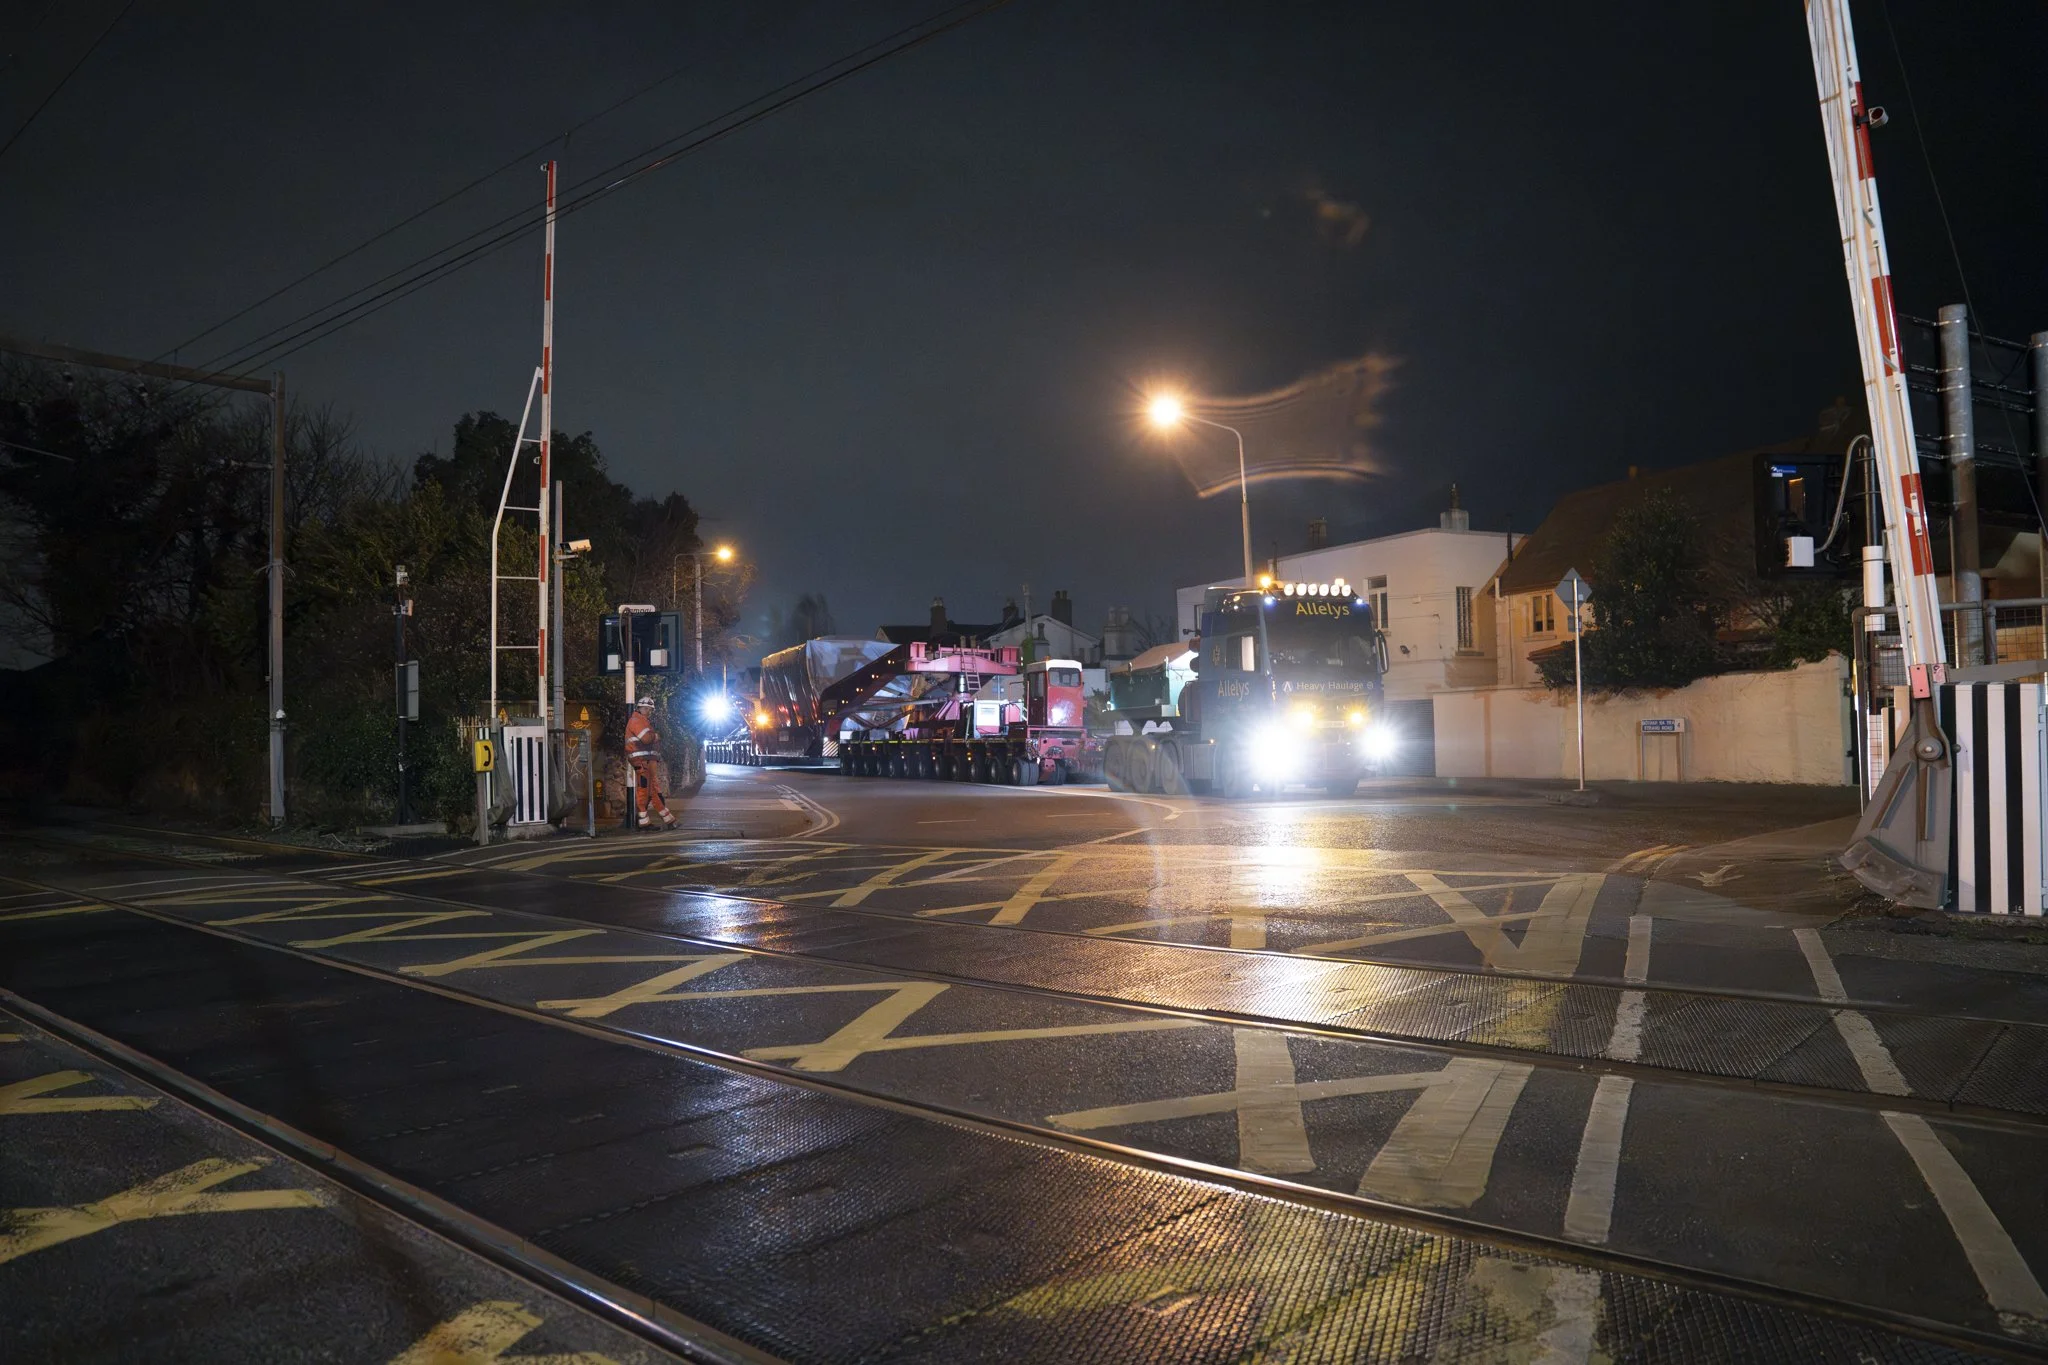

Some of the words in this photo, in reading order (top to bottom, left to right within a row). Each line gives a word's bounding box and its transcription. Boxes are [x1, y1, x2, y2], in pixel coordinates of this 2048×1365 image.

[1296, 602, 1350, 619] Allelys
[1218, 679, 1250, 701] Allelys
[1296, 681, 1325, 690] Heavy
[1328, 681, 1363, 691] Haulage
